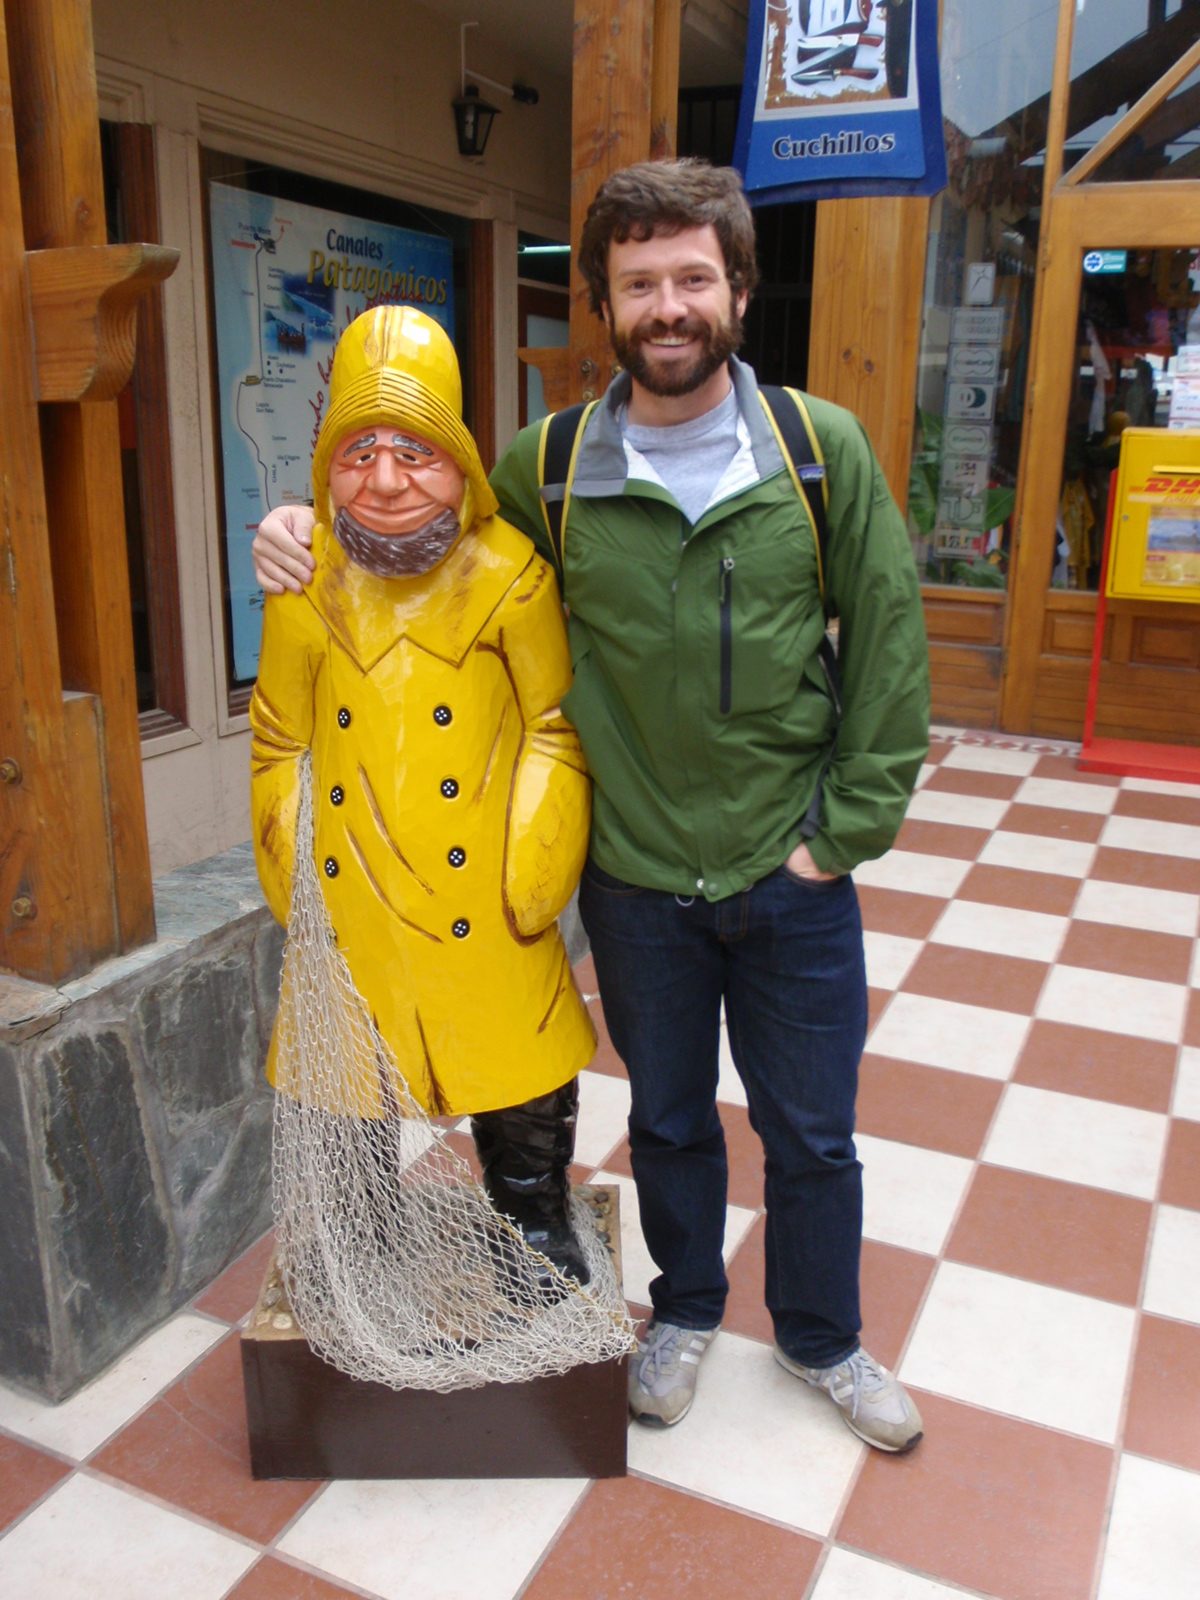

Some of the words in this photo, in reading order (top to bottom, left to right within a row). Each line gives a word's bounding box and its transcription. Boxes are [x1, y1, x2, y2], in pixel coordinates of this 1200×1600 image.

[773, 131, 896, 160] Cuchillos
[326, 228, 384, 260] Canales
[306, 249, 448, 305] Patagónicos
